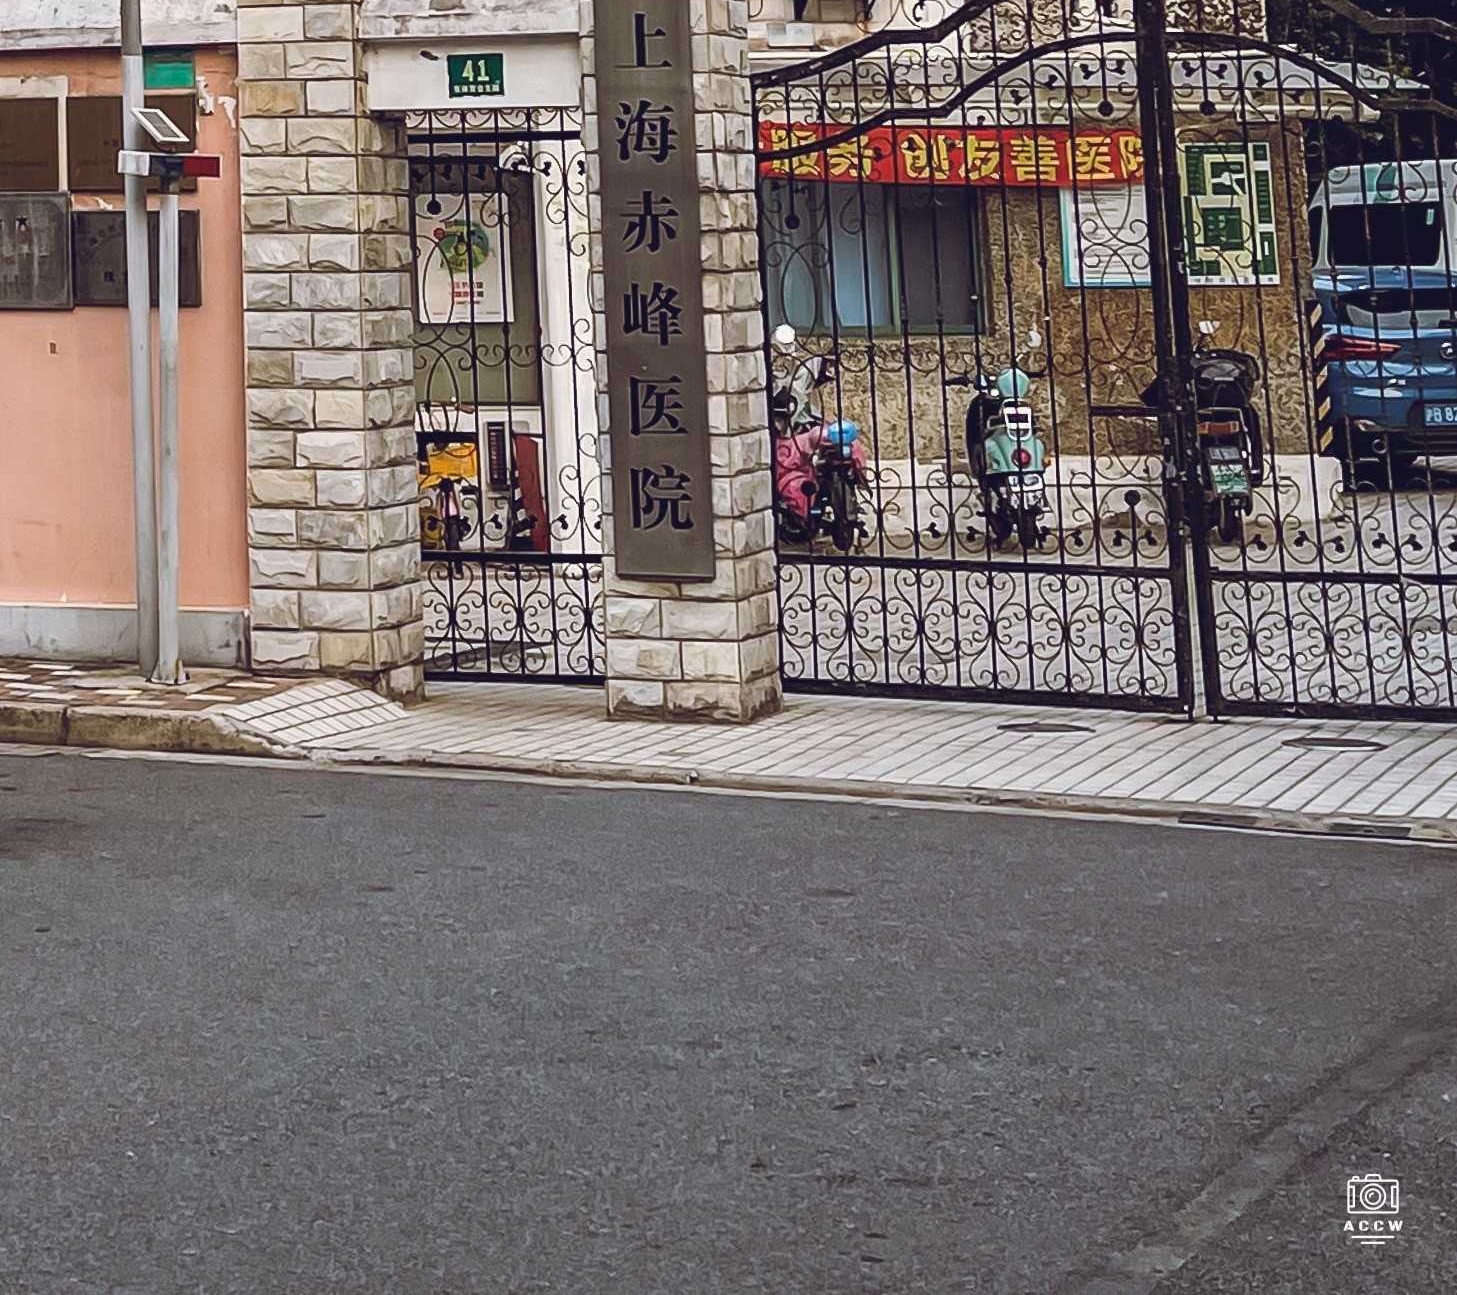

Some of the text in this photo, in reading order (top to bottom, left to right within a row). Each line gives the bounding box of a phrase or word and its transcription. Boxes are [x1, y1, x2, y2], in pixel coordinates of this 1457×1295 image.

[461, 59, 490, 82] 41
[614, 11, 695, 532] 上海赤峰医院
